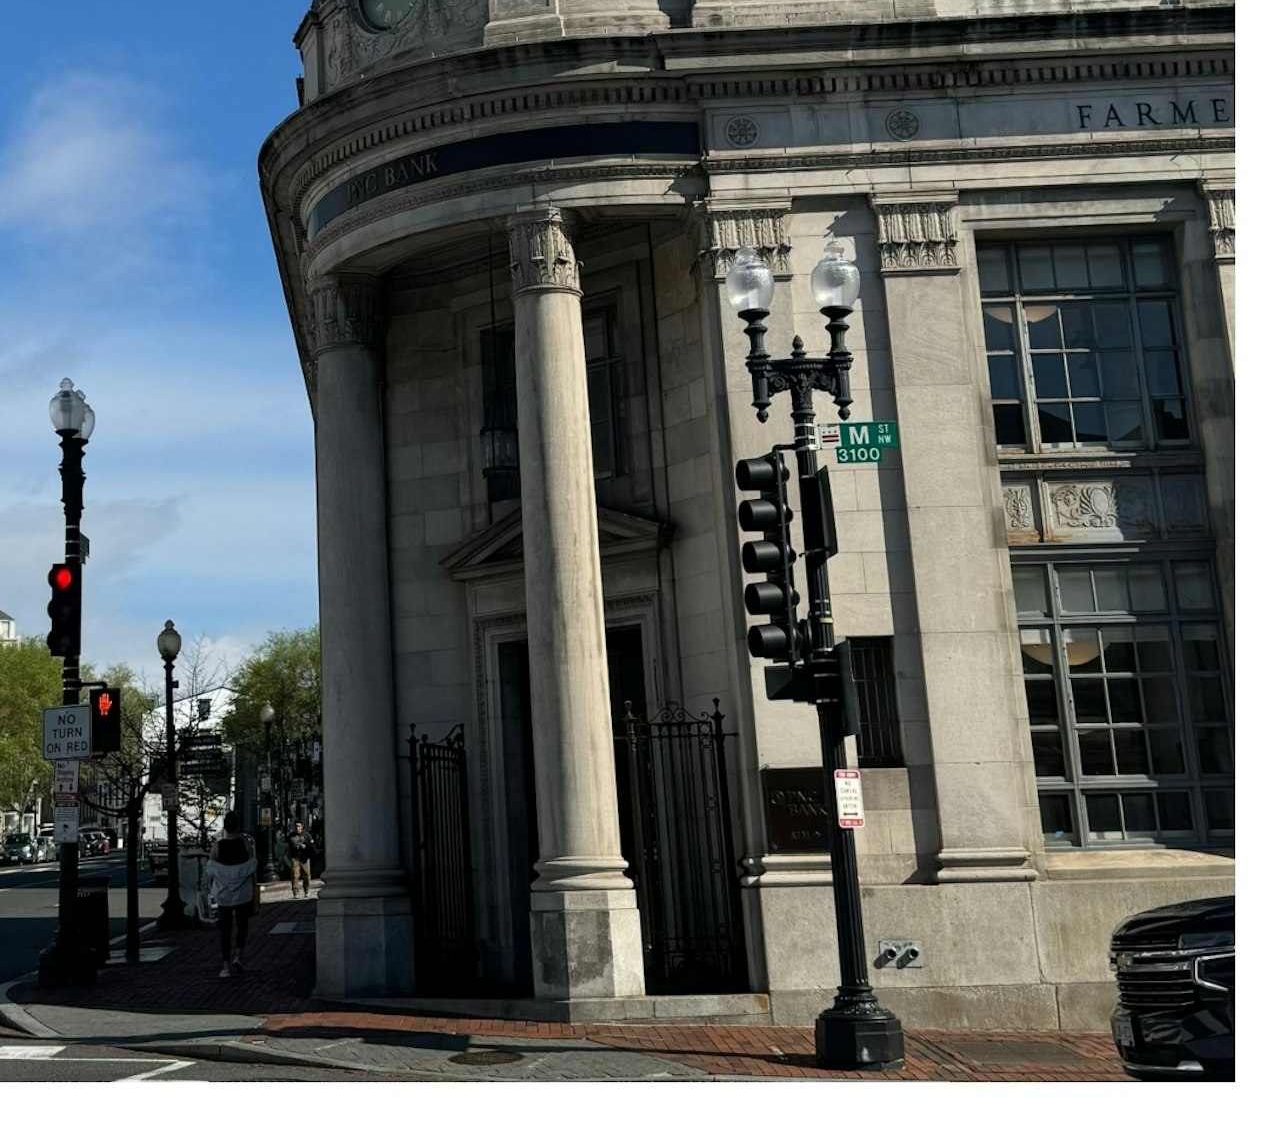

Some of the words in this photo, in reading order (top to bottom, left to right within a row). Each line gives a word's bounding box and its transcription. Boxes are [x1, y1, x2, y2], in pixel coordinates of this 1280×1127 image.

[1076, 98, 1231, 128] FARME
[347, 173, 377, 203] PNC
[384, 152, 439, 186] BANK
[848, 425, 870, 445] M
[878, 424, 889, 433] ST
[878, 435, 892, 444] NW
[838, 447, 880, 461] 3100
[58, 714, 76, 725] NO
[52, 727, 82, 739] TURN
[47, 743, 61, 753] ON
[67, 741, 88, 751] RED
